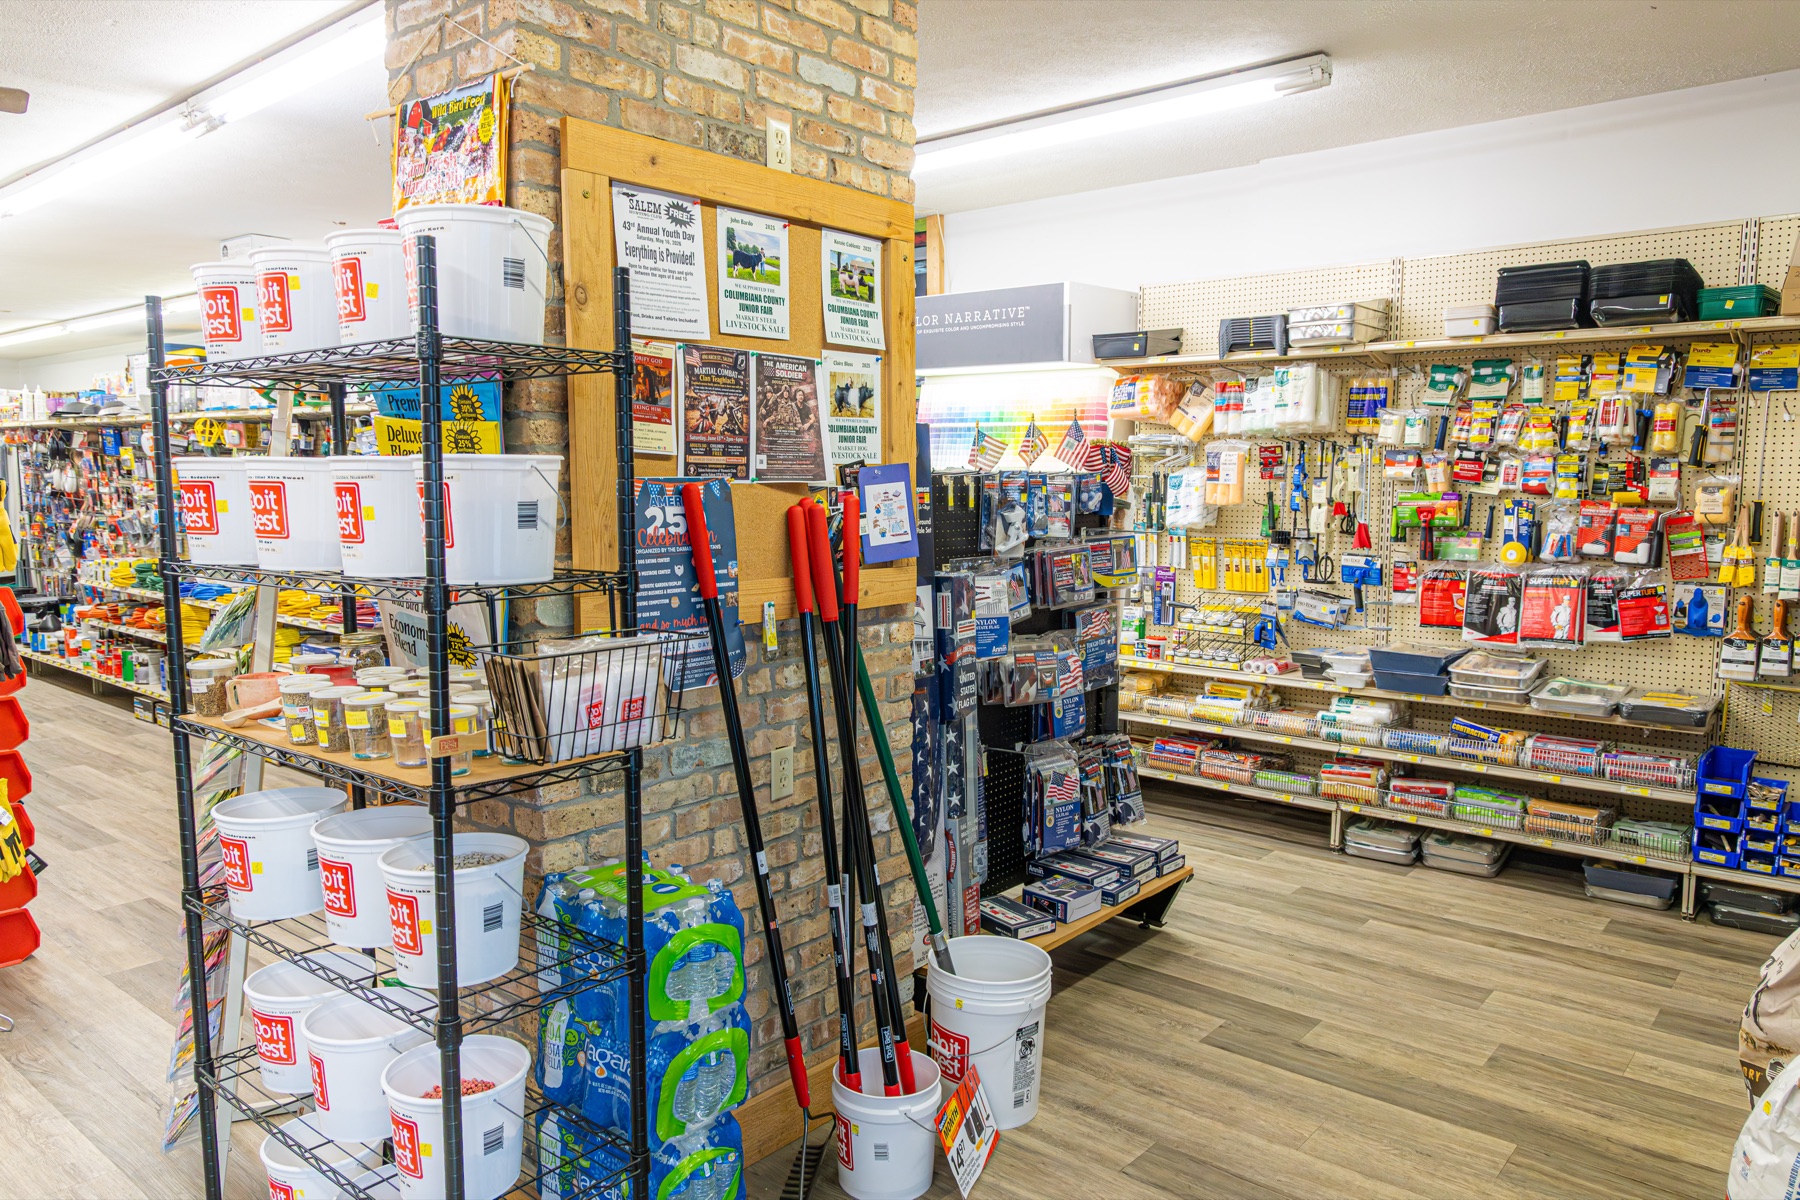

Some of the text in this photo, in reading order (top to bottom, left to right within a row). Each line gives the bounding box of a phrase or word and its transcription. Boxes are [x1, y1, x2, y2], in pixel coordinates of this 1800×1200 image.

[432, 92, 486, 118] Wild Bird Feed
[629, 198, 691, 222] SALEM FREE!
[622, 220, 694, 243] 43rd Annual Youth Day
[624, 242, 695, 266] Everything is Provided!
[342, 268, 354, 290] it
[268, 282, 281, 302] it
[724, 289, 786, 306] COLUMBIANA COUNTY
[217, 294, 230, 314] it
[739, 303, 773, 316] JUNIOR FAIR
[828, 304, 878, 320] COLUMBIANA COUNTY
[726, 320, 786, 334] LIVESTOCK SALE
[736, 314, 777, 324] MARKET STEER
[840, 316, 868, 328] JUNIOR FAIR
[916, 314, 938, 326] LOR
[970, 322, 1010, 330] UNCOMPROMISING
[830, 331, 882, 344] LIVESTOCK SALE
[840, 326, 860, 334] MARKET
[718, 368, 738, 378] COMBAT
[764, 360, 807, 372] THE AMERICAN
[776, 370, 803, 380] SOLDIER
[387, 394, 422, 412] Premi
[387, 426, 422, 444] Deluxe
[858, 426, 878, 434] COUNTY
[838, 435, 866, 444] JUNIOR FAIR
[194, 488, 208, 508] it
[264, 488, 278, 510] it
[342, 490, 354, 513] it
[650, 496, 683, 507] AMER
[640, 614, 698, 632] and so much
[451, 642, 464, 650] 12%
[992, 644, 1007, 652] Annin
[960, 672, 975, 683] UNITED
[960, 685, 975, 696] STATES
[959, 698, 970, 709] FLAG
[1064, 696, 1079, 704] NYLON
[1452, 722, 1488, 740] CONTRACTOR
[1056, 804, 1074, 812] NYLON
[230, 846, 242, 866] it
[1028, 865, 1044, 876] Annin
[332, 869, 346, 889] it
[398, 902, 411, 924] it
[254, 1018, 285, 1040] Do it
[884, 1030, 892, 1046] Best
[258, 1035, 288, 1058] Best
[944, 1106, 958, 1140] MONTH
[398, 1125, 412, 1148] it
